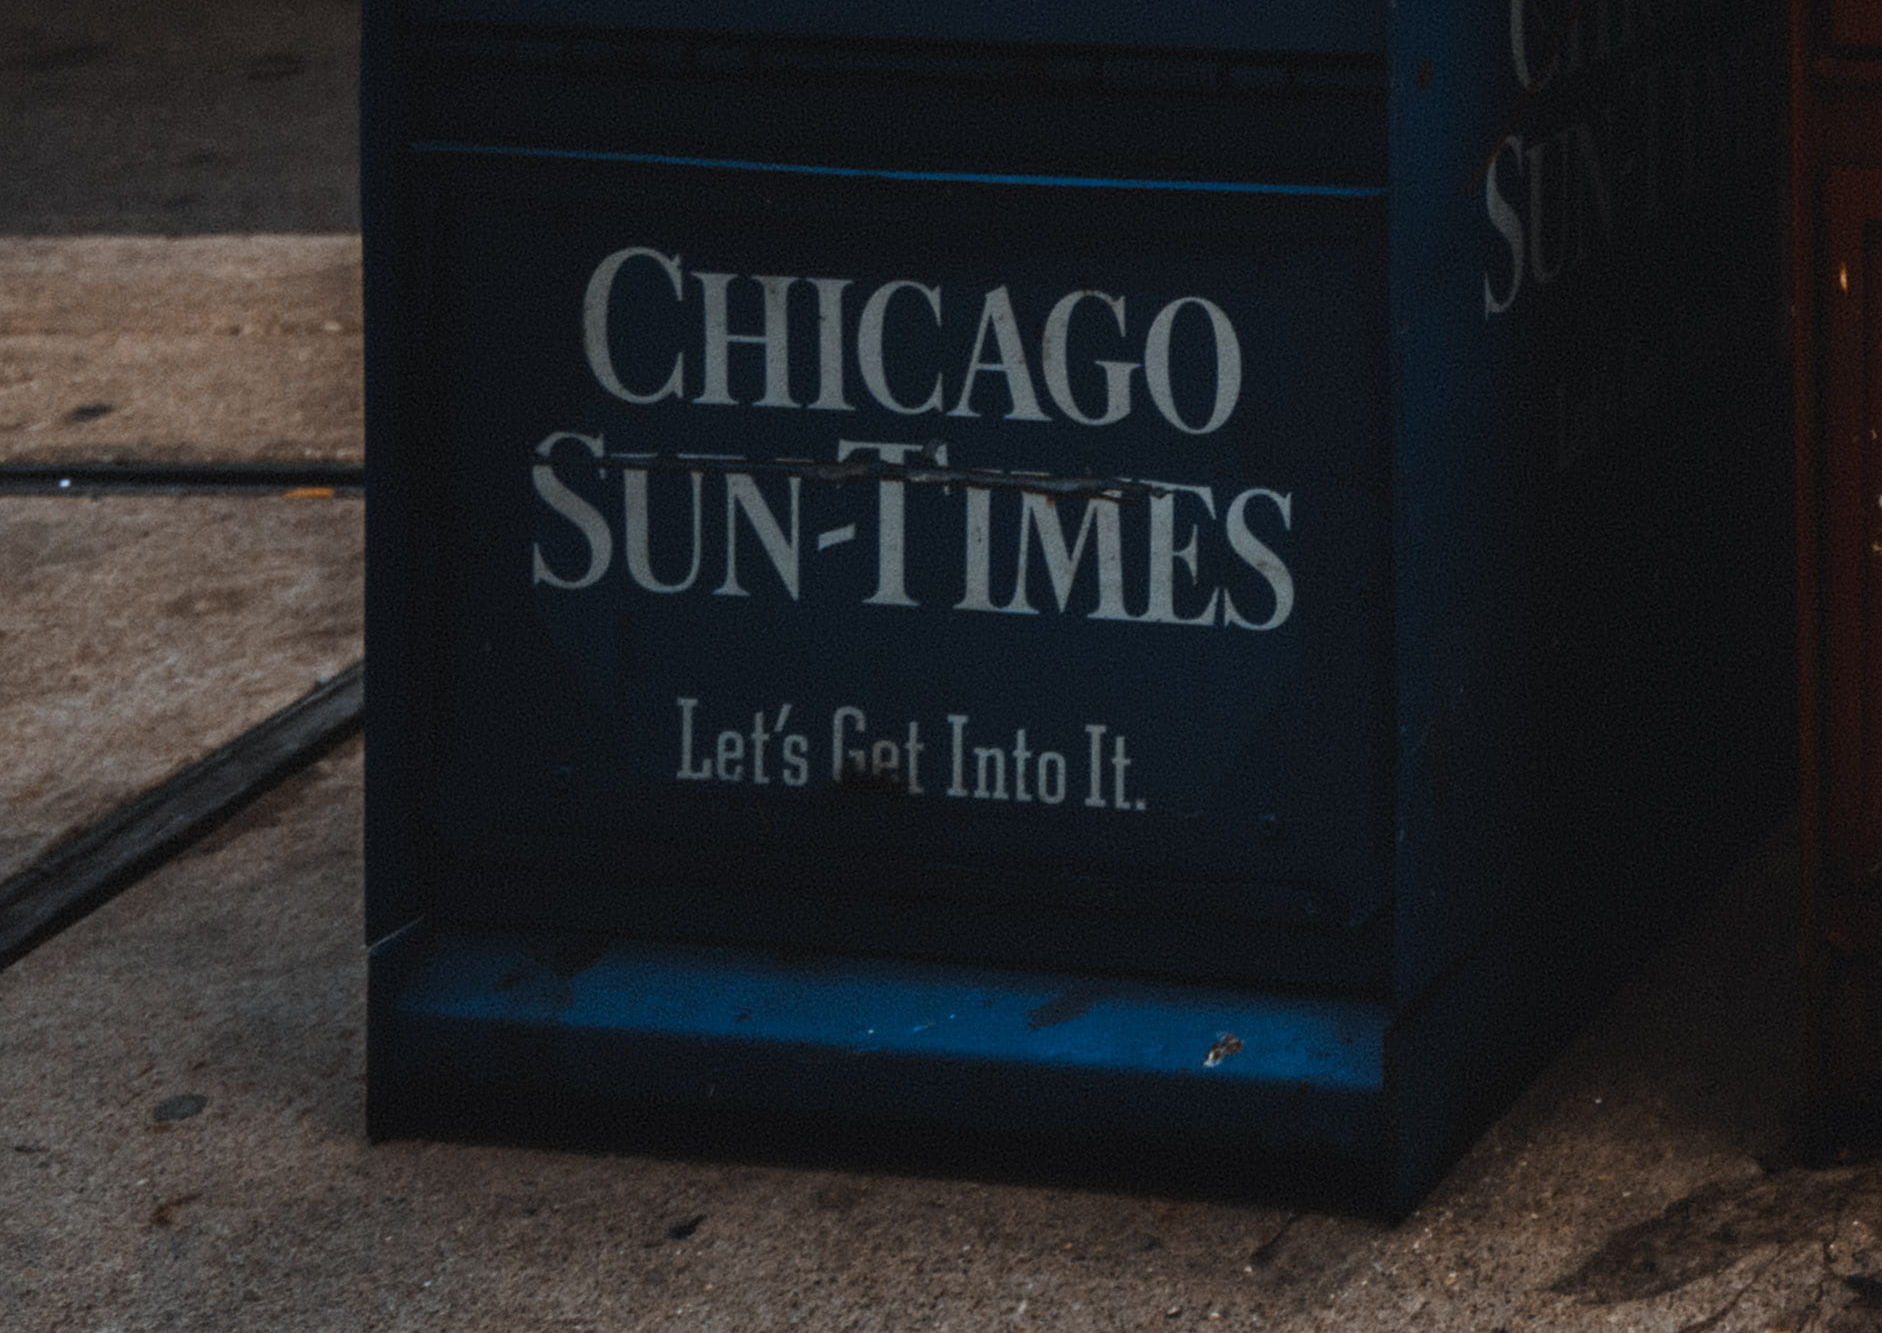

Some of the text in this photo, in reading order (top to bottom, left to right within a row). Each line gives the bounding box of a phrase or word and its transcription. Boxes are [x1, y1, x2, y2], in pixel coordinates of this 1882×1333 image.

[582, 245, 1244, 435] CHICAGO
[530, 431, 1296, 632] SUN-TIMES
[676, 696, 1149, 812] Let's Get Into It.
